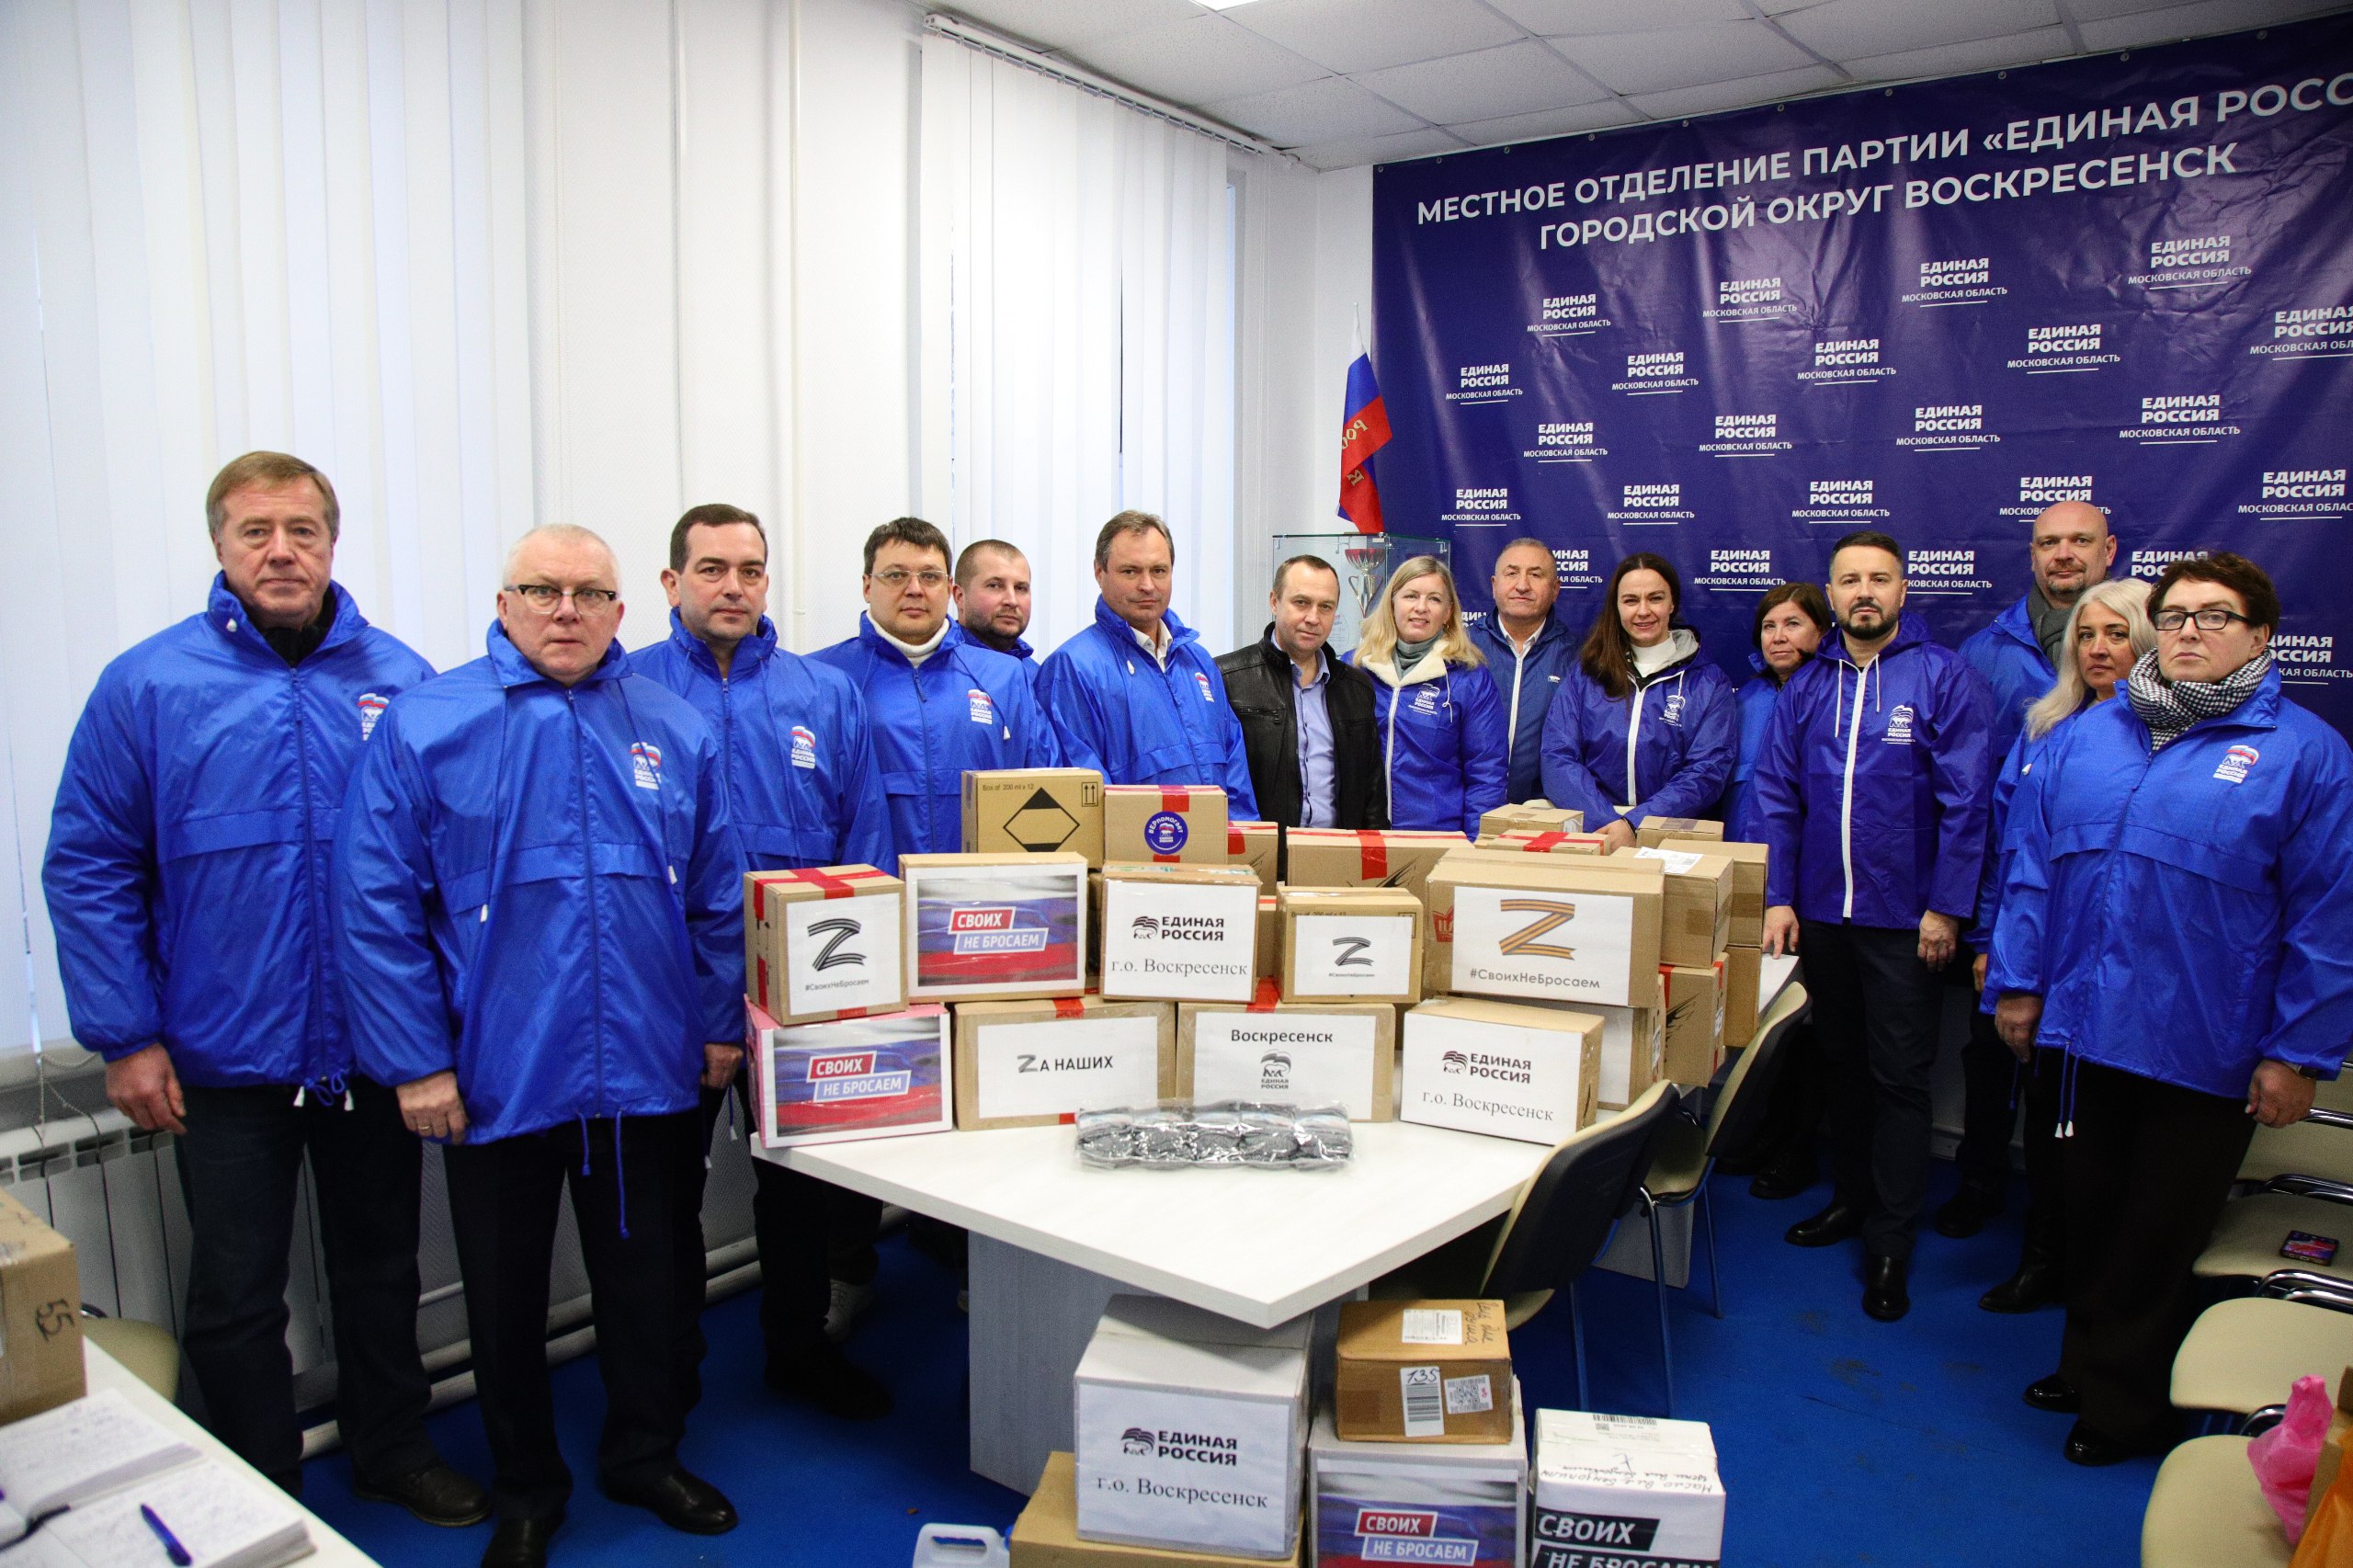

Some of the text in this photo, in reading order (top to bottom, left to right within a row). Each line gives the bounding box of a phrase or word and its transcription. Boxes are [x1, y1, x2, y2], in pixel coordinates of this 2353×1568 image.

[1418, 182, 1564, 224] МЕСТНОЕ
[1575, 152, 1790, 203] ОТДЕЛЕНИЕ
[1803, 129, 1968, 176] ПАРТИИ
[1984, 97, 2199, 153] «ЕДИНАЯ
[1541, 142, 2237, 249] ГОРОДСКОЙ ОКРУГ ВОСКРЕСЕНСК
[2152, 235, 2230, 254] ЕДИНАЯ
[2151, 249, 2229, 267] РОССИЯ
[1920, 258, 1989, 274] ЕДИНАЯ
[1920, 271, 1988, 288] РОССИЯ
[2128, 267, 2251, 284] МОСКОВСКАЯ ОБЛАСТЬ
[1721, 278, 1780, 292] ЕДИНАЯ
[1543, 294, 1596, 308] ЕДИНАЯ
[1721, 290, 1780, 304] РОССИЯ
[1902, 287, 2007, 302] МОСКОВСКАЯ ОБЛАСТЬ
[1542, 305, 1596, 320] РОССИЯ
[1703, 304, 1797, 317] МОСКОВСКАЯ ОБЛАСТЬ
[1527, 320, 1611, 332] МОСКОВСКАЯ ОБЛАСТЬ
[2029, 324, 2101, 340] ЕДИНАЯ
[1815, 339, 1879, 354] ЕДИНАЯ
[2029, 337, 2100, 353] РОССИЯ
[2250, 342, 2327, 354] МОСКОВСКАЯ
[1628, 352, 1684, 366] ЕДИНАЯ
[1815, 352, 1878, 366] РОССИЯ
[2007, 355, 2120, 368] МОСКОВСКАЯ ОБЛАСТЬ
[1461, 364, 1509, 377] ЕДИНАЯ
[1628, 364, 1683, 377] РОССИЯ
[1797, 368, 1896, 380] МОСКОВСКАЯ ОБЛАСТЬ
[1461, 375, 1508, 388] РОССИЯ
[1612, 379, 1699, 390] МОСКОВСКАЯ ОБЛАСТЬ
[1445, 391, 1491, 400] МОСКОВСКАЯ
[2143, 395, 2220, 410] ЕДИНАЯ
[1915, 405, 1982, 419] ЕДИНАЯ
[2142, 409, 2219, 423] РОССИЯ
[1715, 415, 1776, 426] ЕДИНАЯ
[1915, 418, 1982, 432] РОССИЯ
[1539, 423, 1593, 434] ЕДИНАЯ
[1715, 426, 1776, 438] РОССИЯ
[2120, 426, 2240, 437] МОСКОВСКАЯ ОБЛАСТЬ
[1539, 434, 1593, 445] РОССИЯ
[1896, 435, 2000, 445] МОСКОВСКАЯ ОБЛАСТЬ
[1524, 449, 1573, 457] МОСКОВСКАЯ
[1699, 443, 1754, 451] МОСКОВСКАЯ
[2020, 476, 2092, 489] ЕДИНАЯ
[2263, 470, 2346, 484] ЕДИНАЯ
[1456, 488, 1507, 499] ЕДИНАЯ
[1624, 484, 1679, 495] ЕДИНАЯ
[1810, 481, 1872, 493] ЕДИНАЯ
[2262, 484, 2345, 498] РОССИЯ
[1624, 496, 1679, 507] РОССИЯ
[1810, 493, 1872, 505] РОССИЯ
[2020, 490, 2091, 502] РОССИЯ
[1456, 499, 1507, 509] РОССИЯ
[2238, 504, 2313, 513] МОСКОВСКАЯ
[1792, 509, 1848, 517] МОСКОВСКАЯ
[1552, 551, 1588, 559] ИНАЯ
[1711, 551, 1770, 561] ЕДИНАЯ
[1908, 551, 1974, 562] ЕДИНАЯ
[1556, 562, 1588, 571] ССИЯ
[1711, 562, 1769, 573] РОССИЯ
[1908, 563, 1973, 574] РОССИЯ
[2131, 564, 2168, 576] РОС
[1951, 580, 1992, 588] ОБЛАСТЬ
[2266, 635, 2333, 647] ДИНАЯ
[2269, 649, 2331, 663] ОССИЯ
[2303, 669, 2353, 677] ОБЛАСТЬ
[958, 913, 1002, 927] СВОИХ
[1162, 916, 1224, 927] ЕДИНАЯ
[1162, 929, 1223, 941] РОССИЯ
[964, 935, 1039, 949] НЕ БРОСАЕМ
[1112, 959, 1247, 977] г.о. Воскресенск
[1470, 968, 1600, 988] #СвоихНеБросаем
[805, 980, 869, 991] #СвоихНеБросаем
[1232, 1029, 1333, 1044] Воскресенск
[816, 1058, 863, 1075] СВОИХ
[1055, 1056, 1113, 1071] НАШИХ
[1471, 1053, 1531, 1070] ЕДИНАЯ
[1470, 1066, 1530, 1084] РОССИЯ
[824, 1077, 902, 1096] НЕ БРОСАЕМ
[1423, 1092, 1553, 1120] г.о. Воскресенск
[1158, 1431, 1236, 1449] ЕДИНАЯ
[1158, 1446, 1236, 1466] РОССИЯ
[1098, 1478, 1267, 1507] г.о. Воскресенск
[1367, 1516, 1421, 1533] СВОИХ
[1538, 1515, 1635, 1545] СВОИХ
[1372, 1540, 1466, 1560] НЕ БРОСАЕМ
